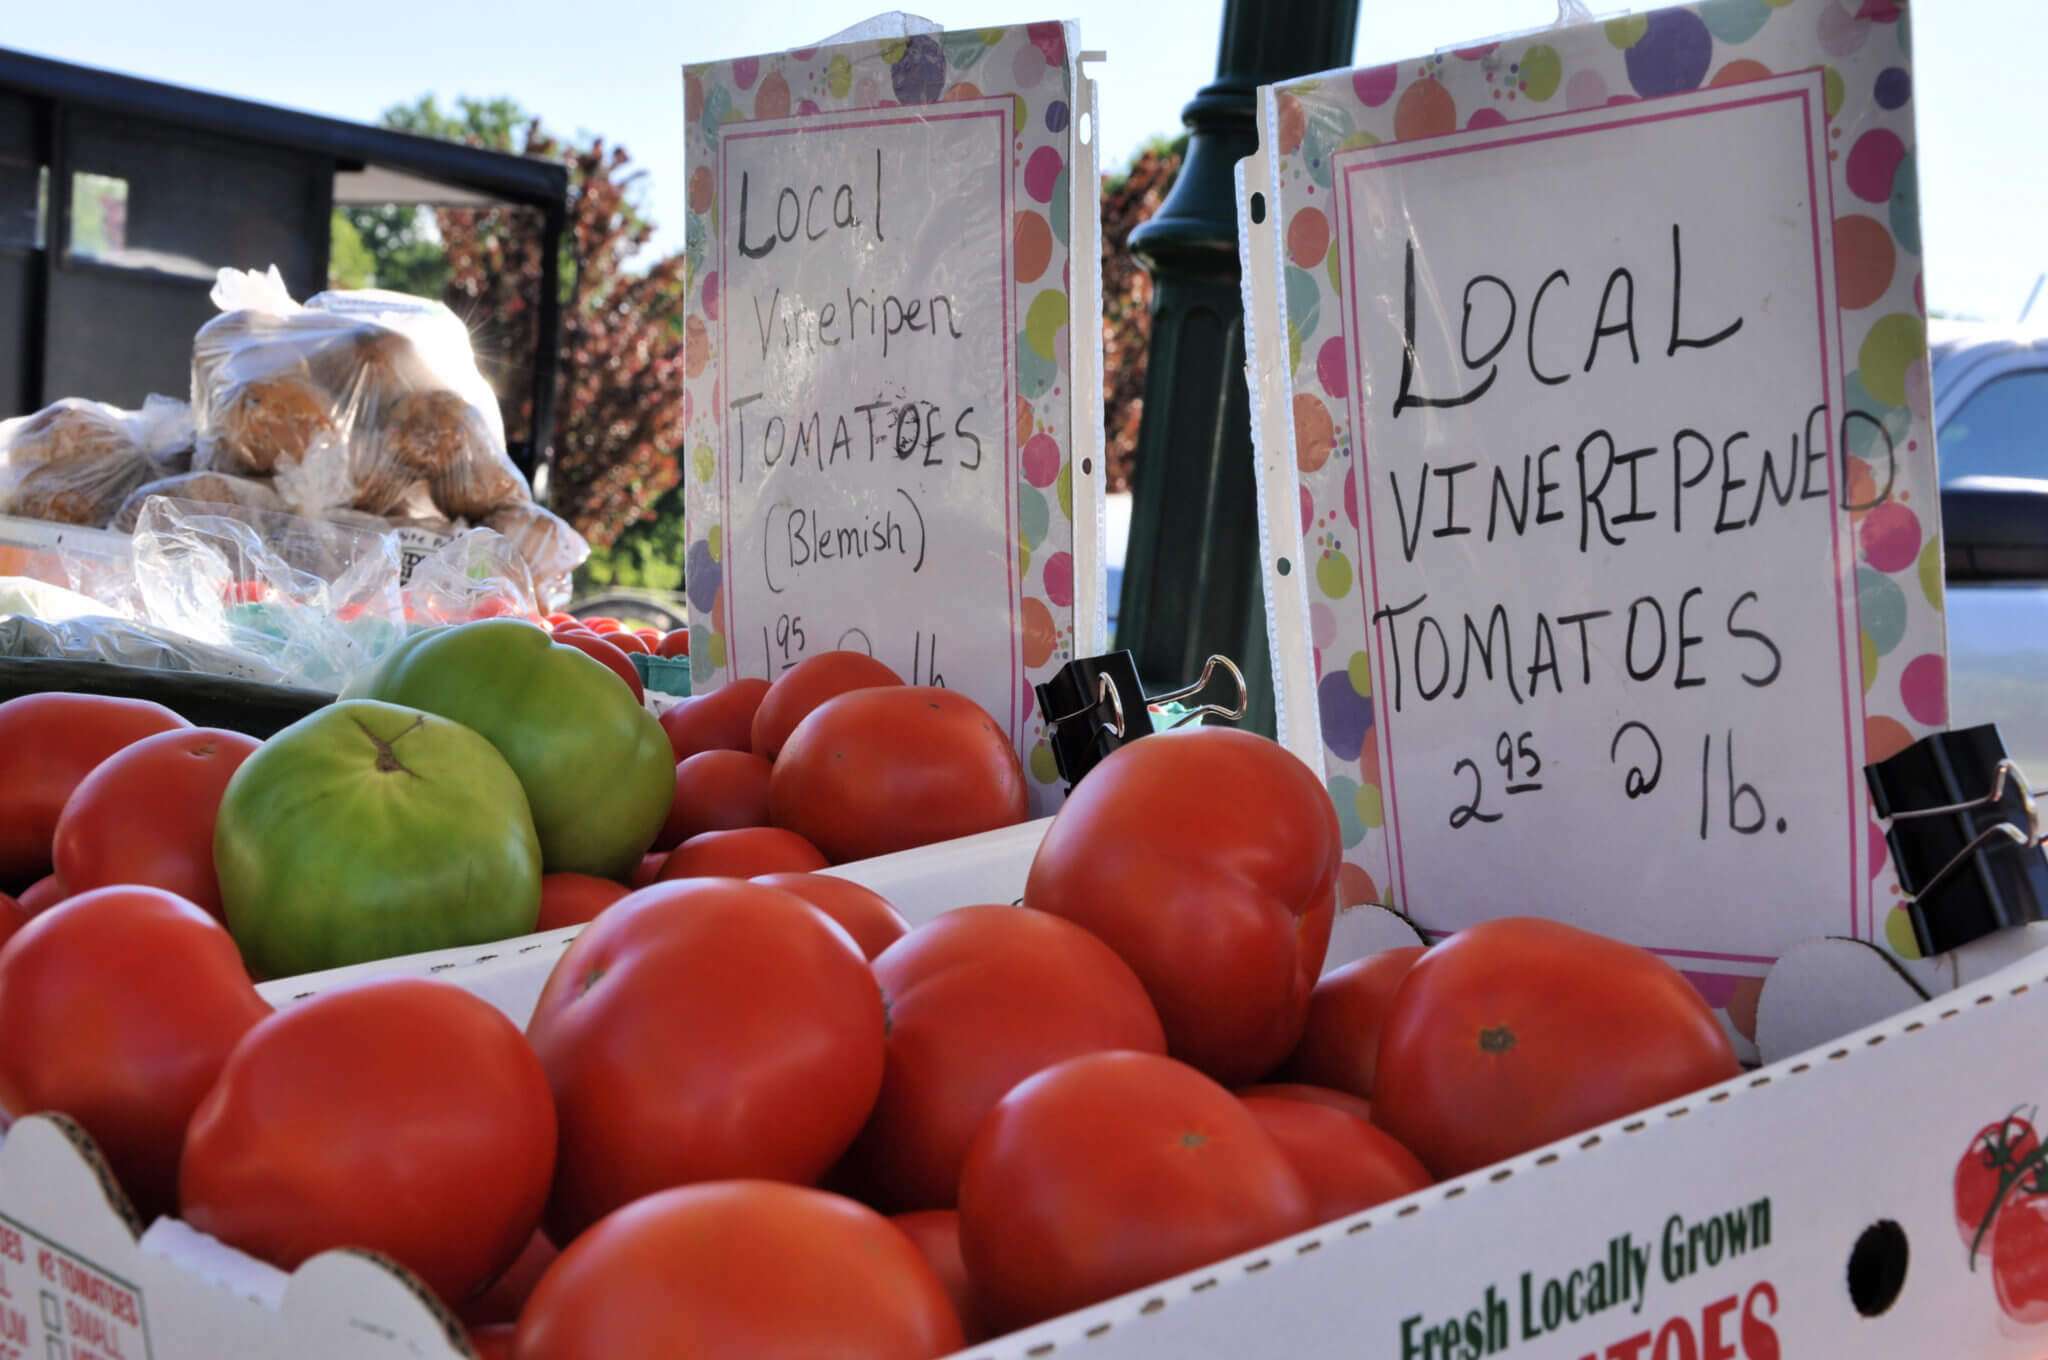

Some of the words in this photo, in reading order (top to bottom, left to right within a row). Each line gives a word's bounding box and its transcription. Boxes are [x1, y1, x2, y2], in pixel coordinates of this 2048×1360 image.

[738, 148, 884, 259] Local
[1393, 223, 1744, 418] LOCAL
[730, 392, 982, 483] TOMATOES
[1390, 403, 1897, 563] VINERIPENED
[764, 488, 925, 593] (Blemish)
[1373, 587, 1783, 712] TOMATOES
[1400, 1284, 1509, 1360] Fresh
[1520, 1231, 1651, 1342] Locally
[1660, 1196, 1772, 1284] Grown
